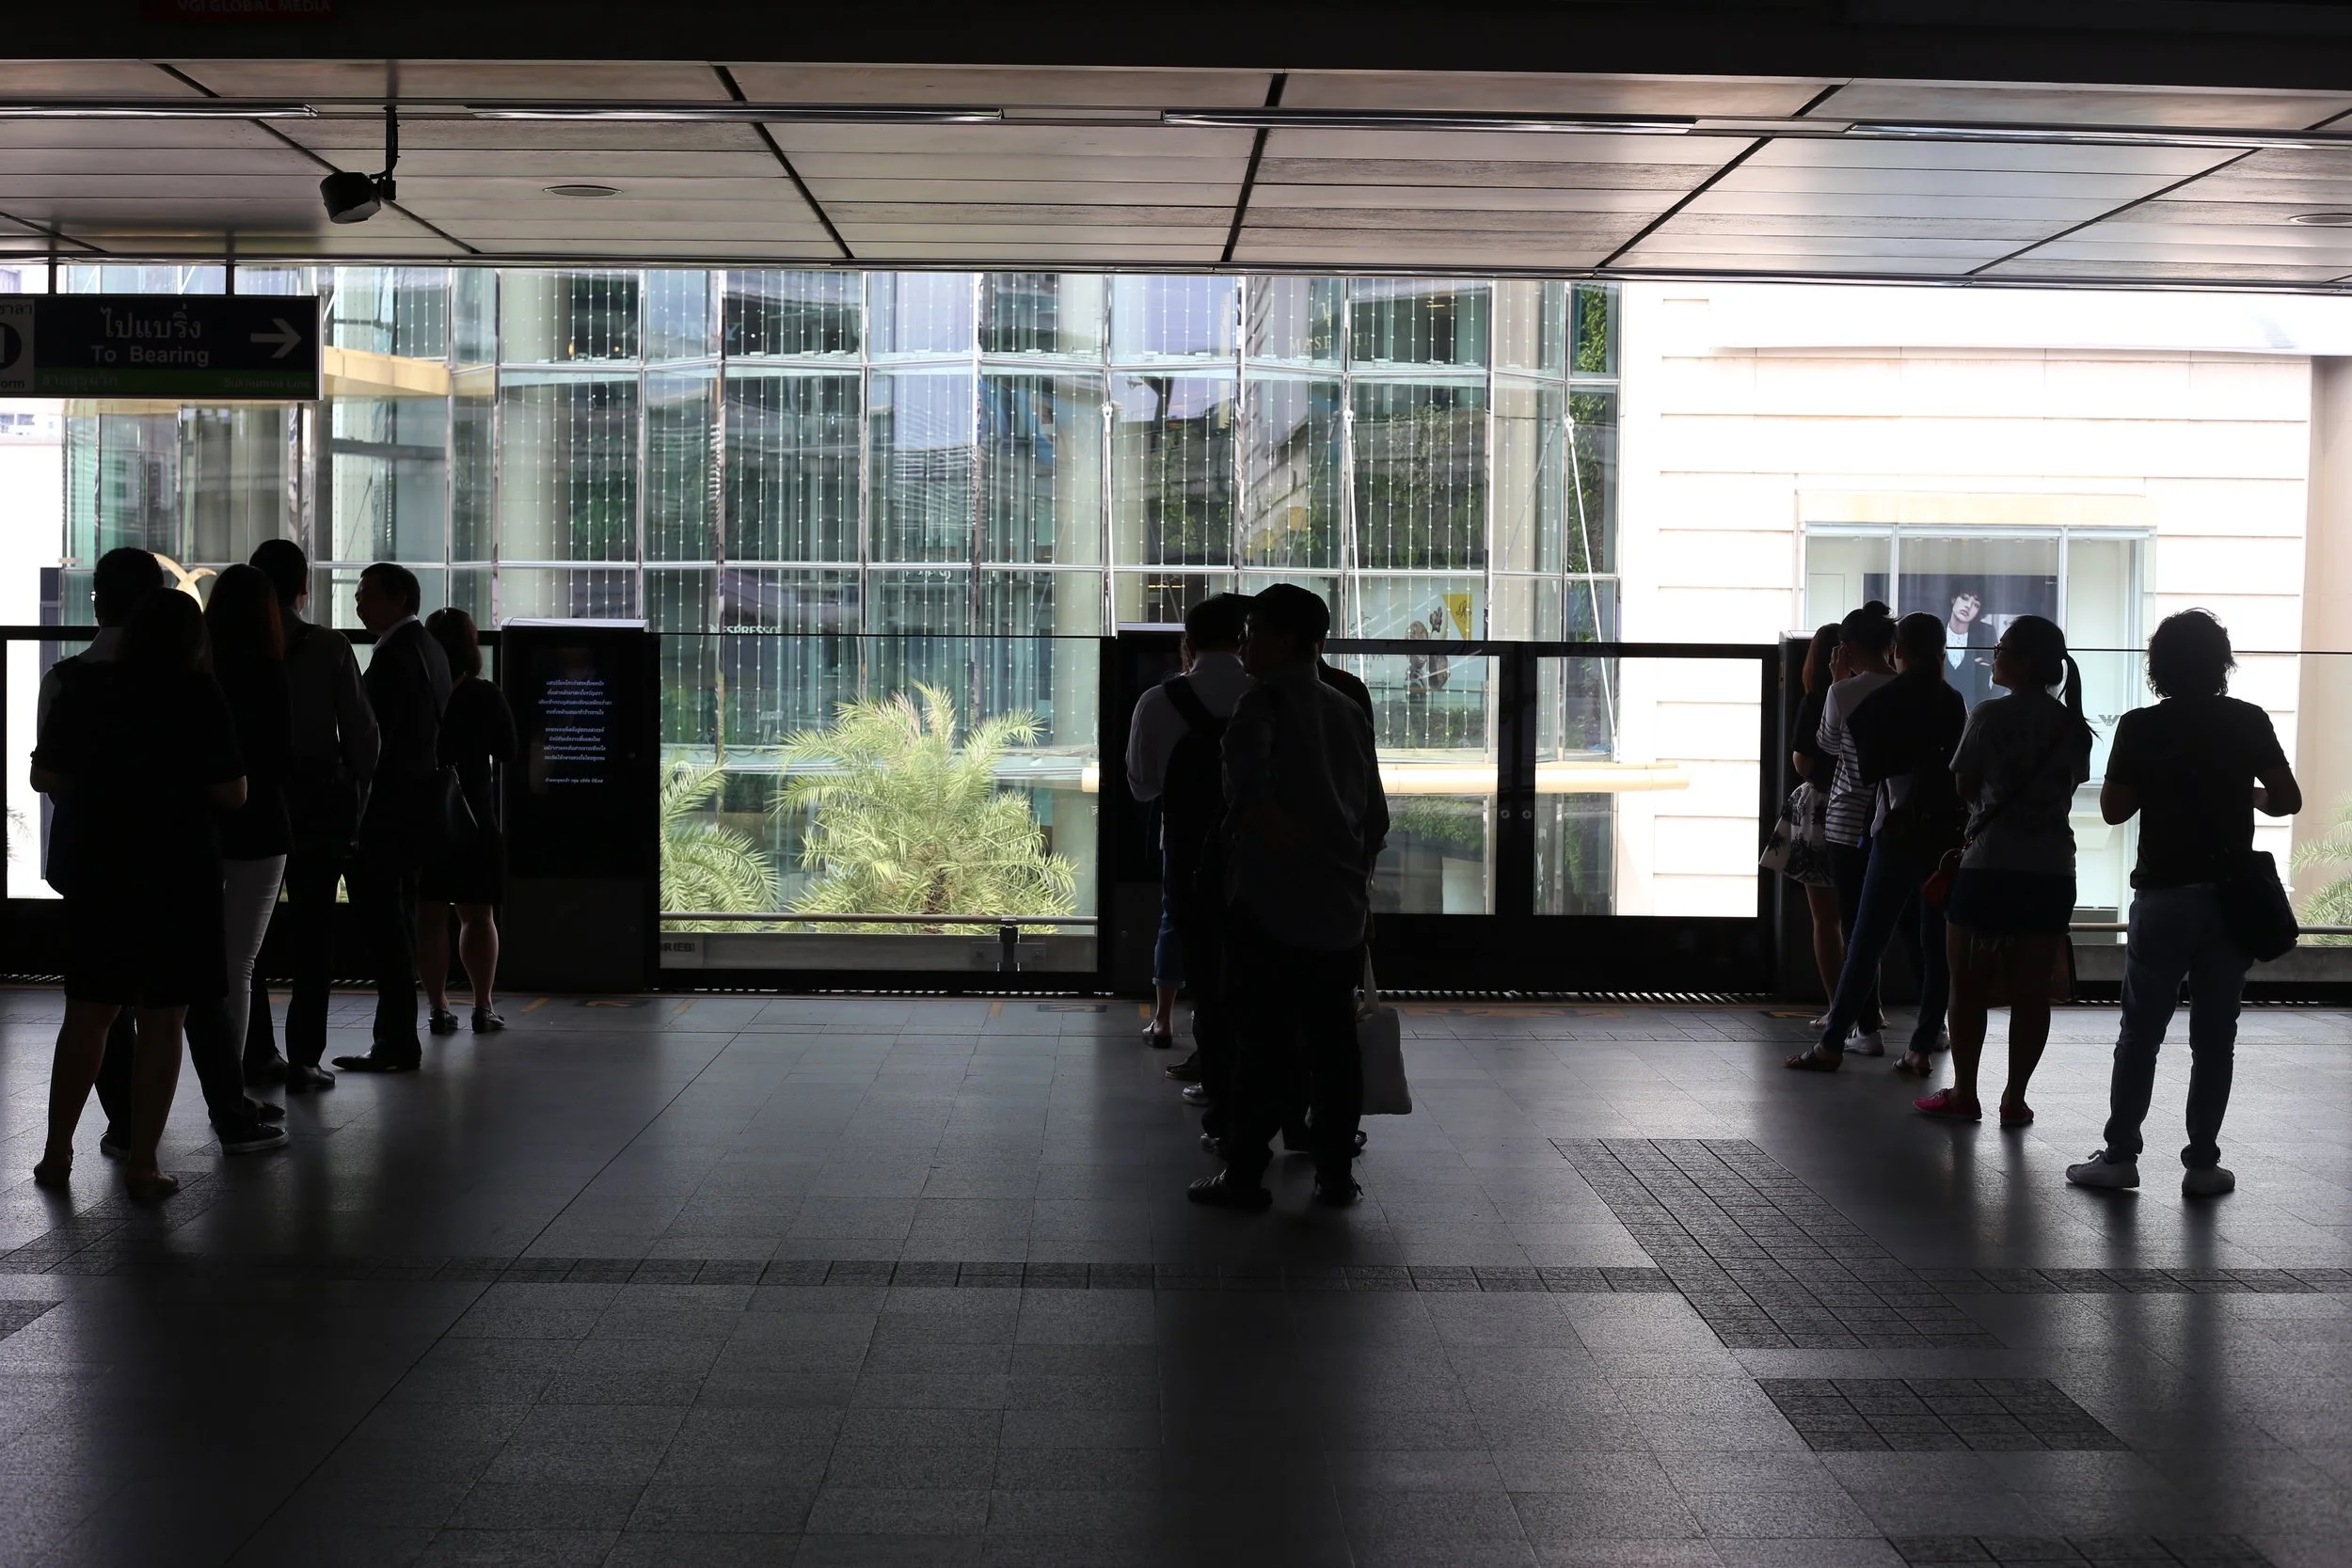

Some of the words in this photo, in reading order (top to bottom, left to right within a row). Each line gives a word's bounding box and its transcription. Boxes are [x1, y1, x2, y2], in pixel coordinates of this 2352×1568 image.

[177, 0, 206, 12] VGI
[210, 0, 276, 12] GLOBAL
[278, 0, 331, 12] MEDIA
[100, 303, 201, 341] ไปแบริ่ง
[1291, 332, 1369, 352] MASETI
[90, 344, 117, 363] To
[130, 344, 210, 368] Bearing
[660, 942, 695, 953] R(EB)
